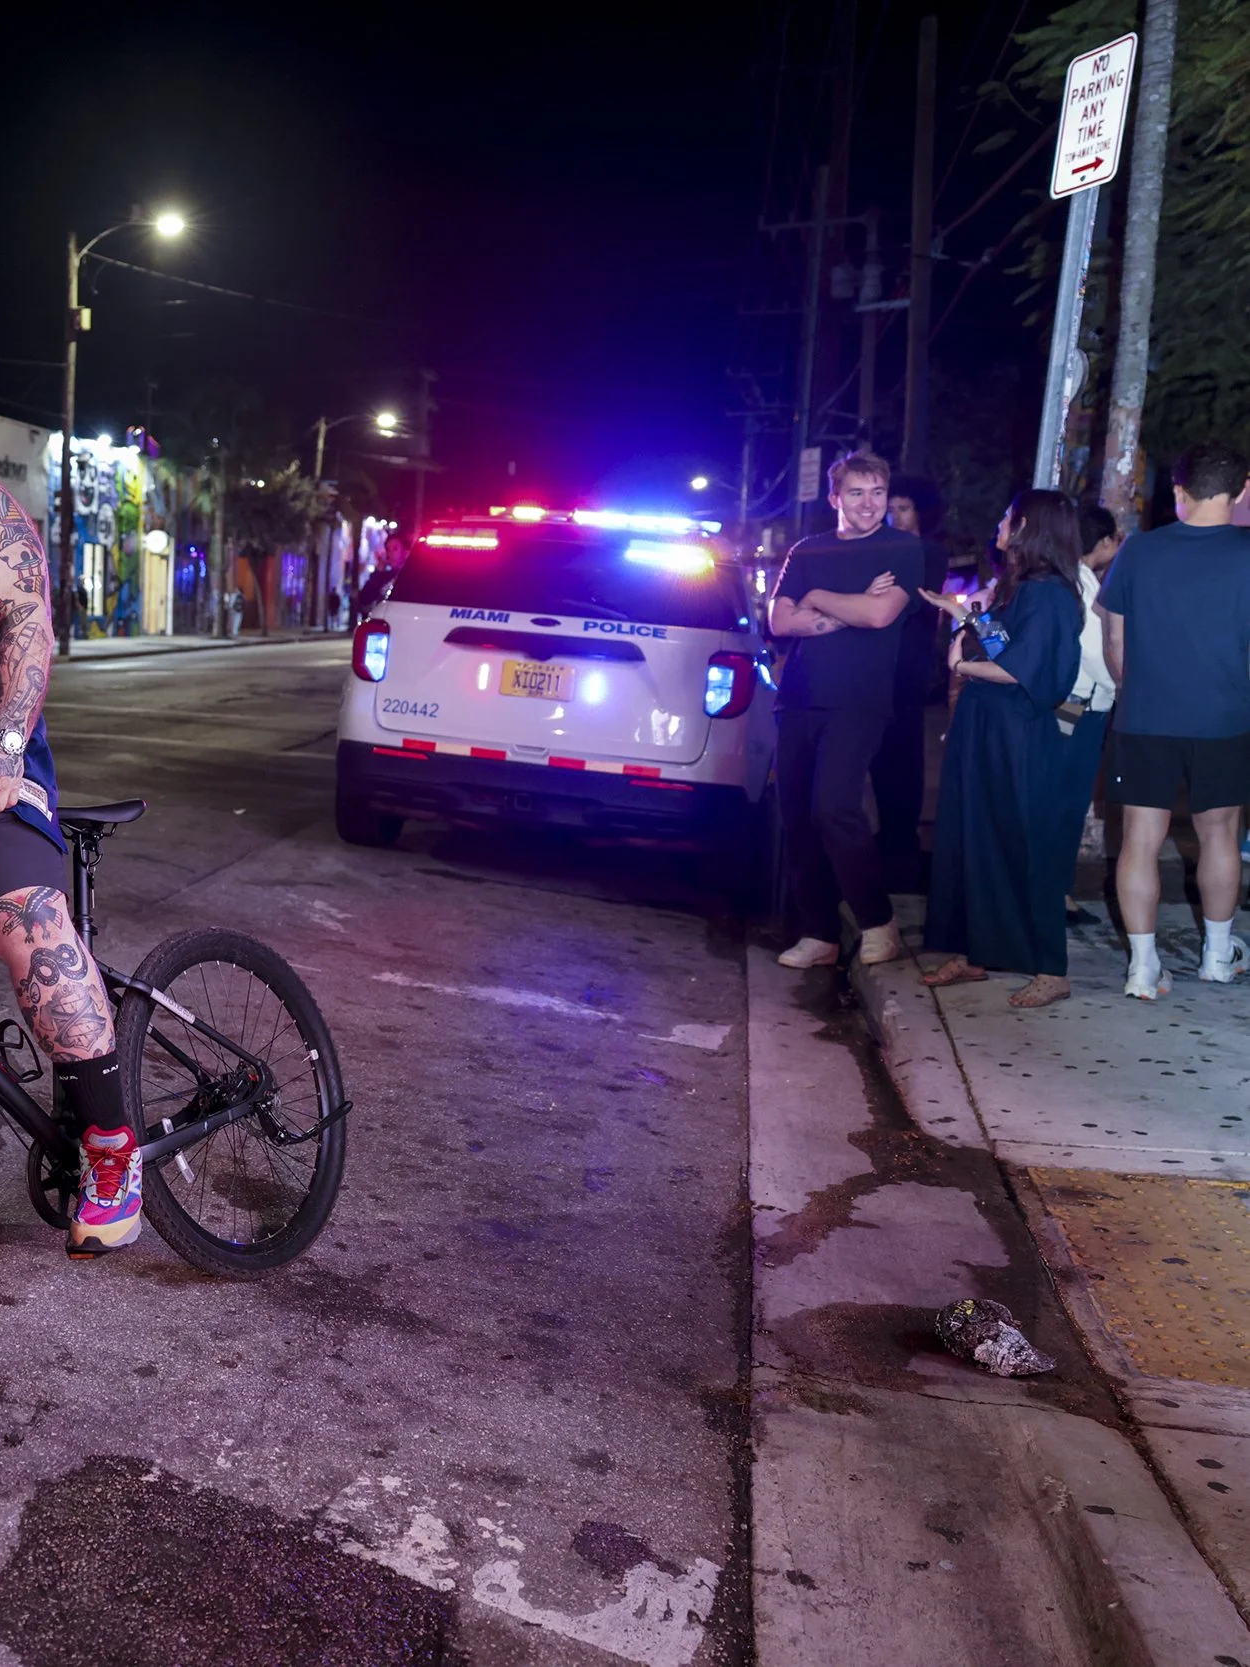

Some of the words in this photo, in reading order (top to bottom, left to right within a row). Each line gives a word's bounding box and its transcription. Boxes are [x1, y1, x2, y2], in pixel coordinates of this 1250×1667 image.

[1092, 53, 1110, 76] NO
[1070, 69, 1125, 106] PARKING
[1080, 97, 1108, 123] ANY
[1077, 120, 1105, 144] TIME
[1065, 146, 1093, 164] TOW-AWAY
[1095, 138, 1111, 156] ZONE
[450, 608, 511, 623] MIAMI
[583, 620, 668, 639] POLICE
[382, 698, 439, 718] 220442
